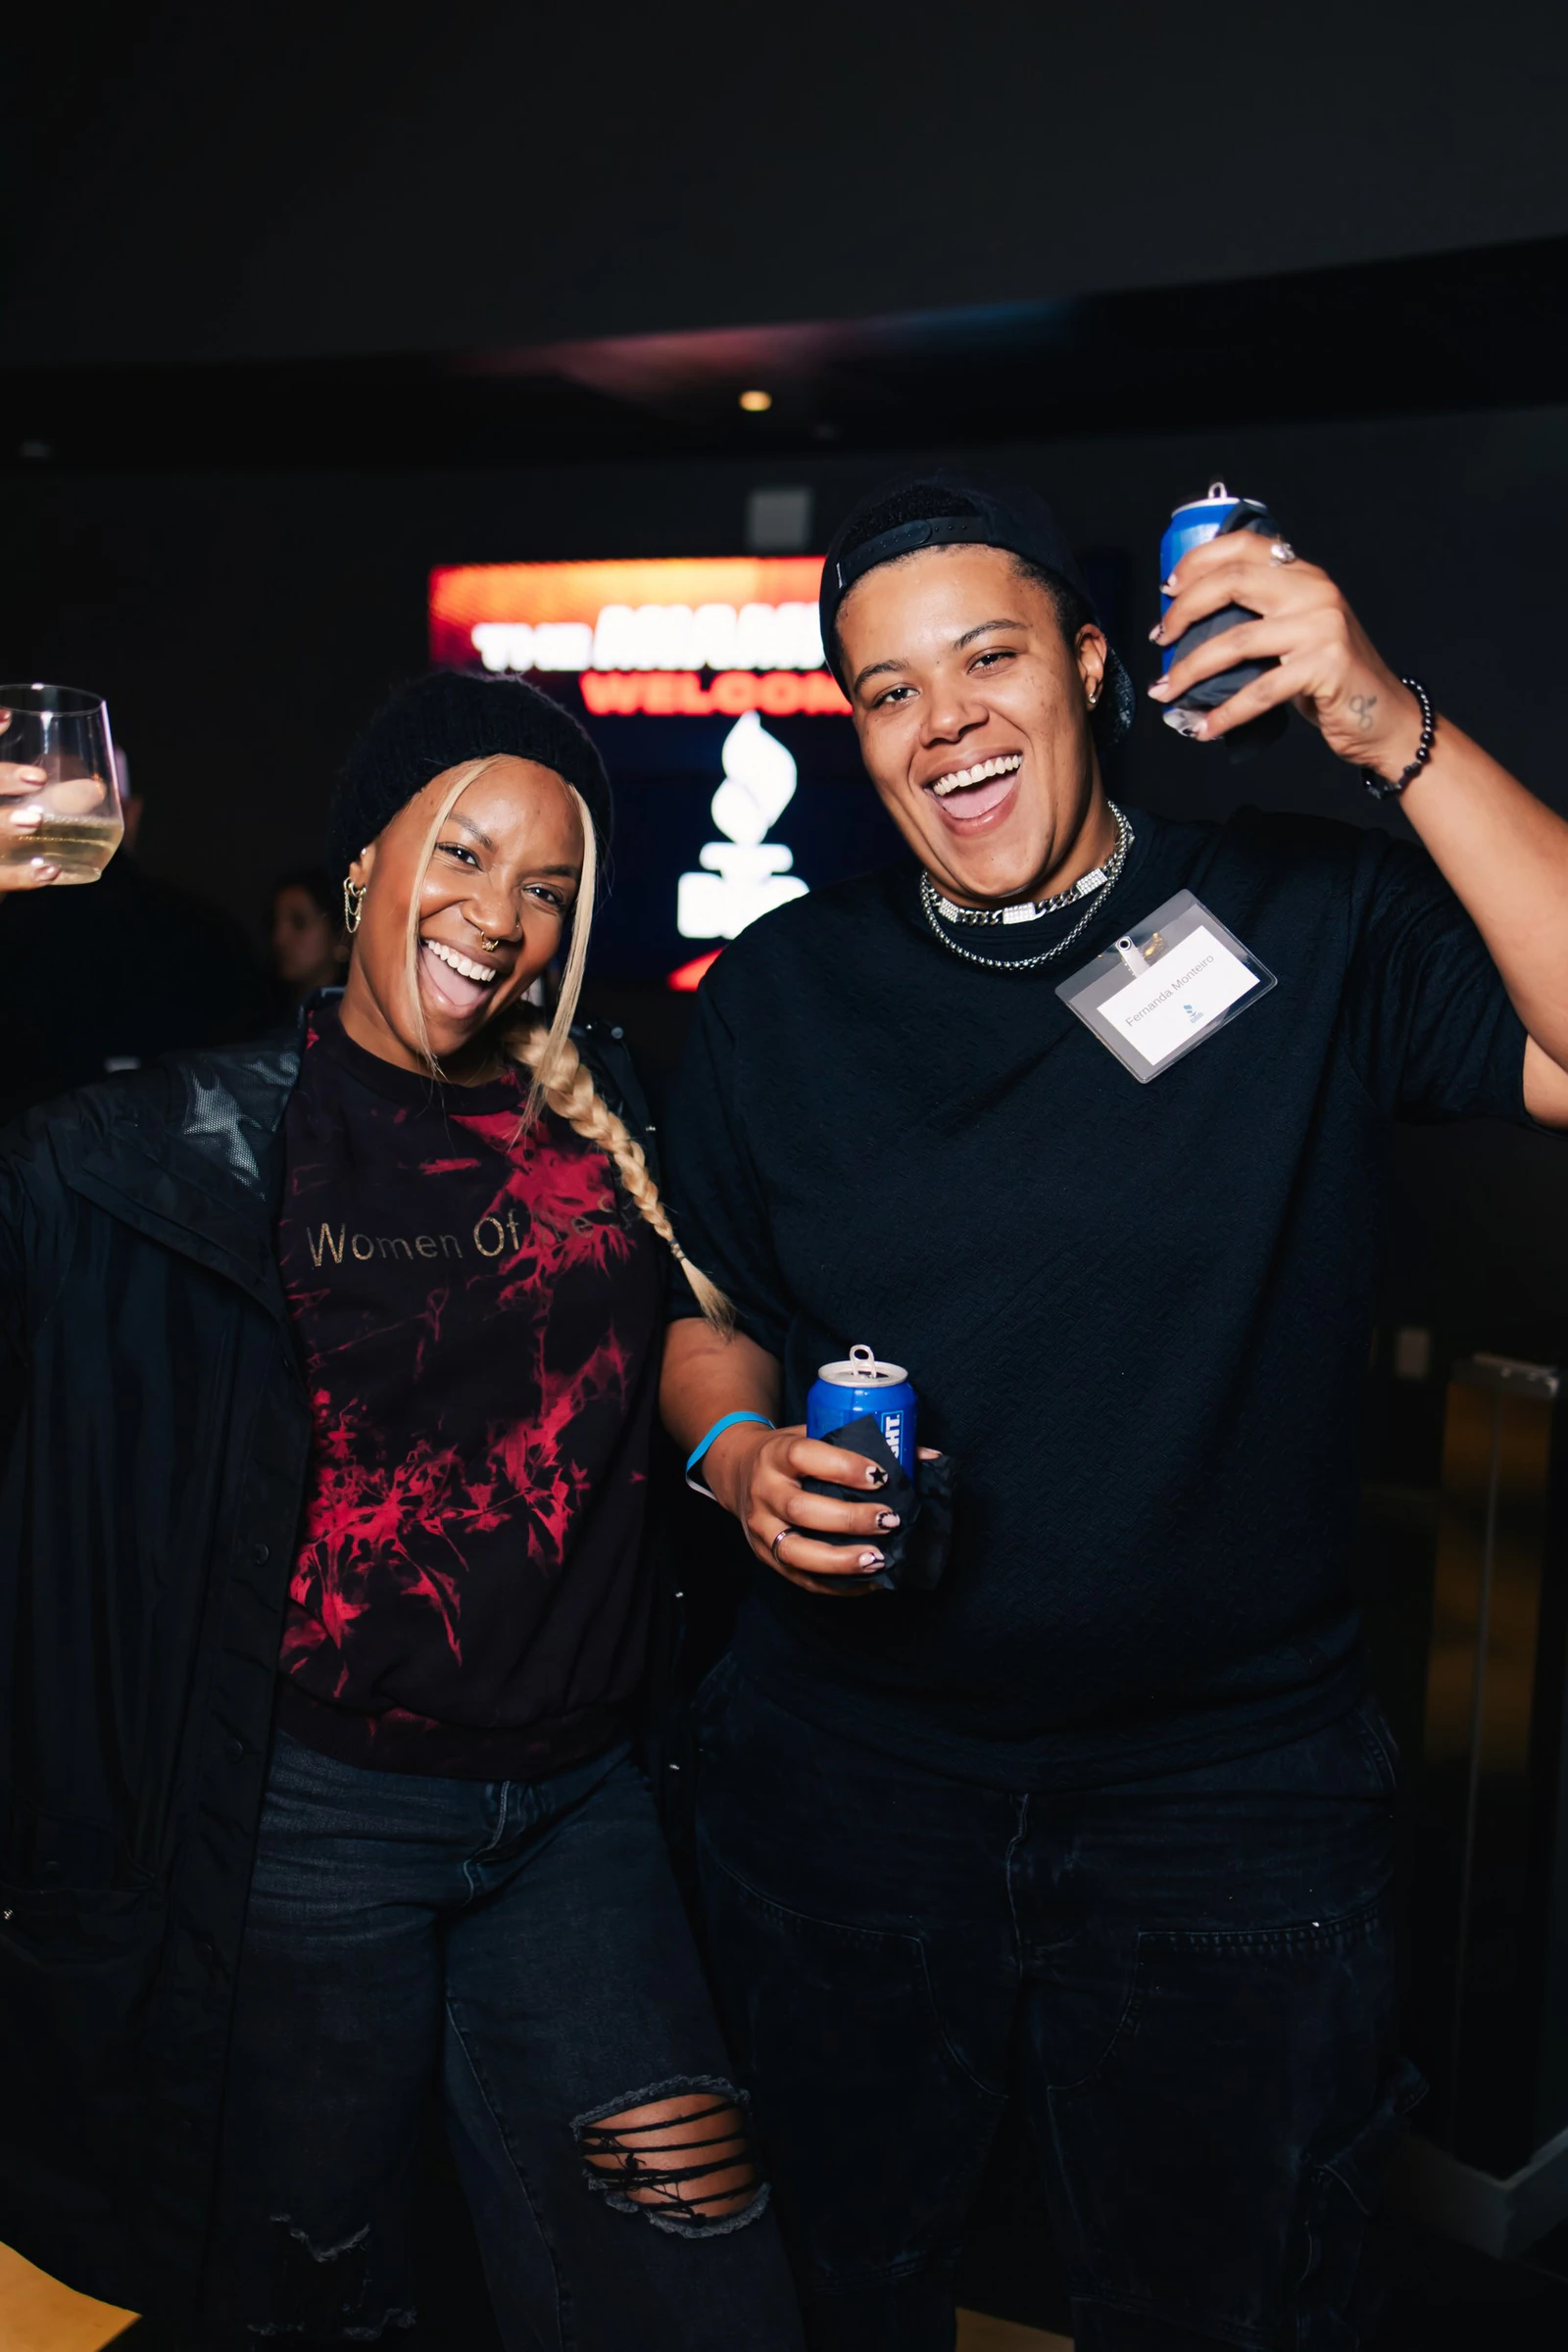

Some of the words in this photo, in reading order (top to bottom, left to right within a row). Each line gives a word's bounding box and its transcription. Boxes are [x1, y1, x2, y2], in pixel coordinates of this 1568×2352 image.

[581, 671, 853, 715] WELCOM
[1125, 989, 1173, 1027] Fernanda
[1171, 955, 1214, 991] Monteiro
[306, 1221, 464, 1270] Women
[473, 1208, 521, 1258] Of
